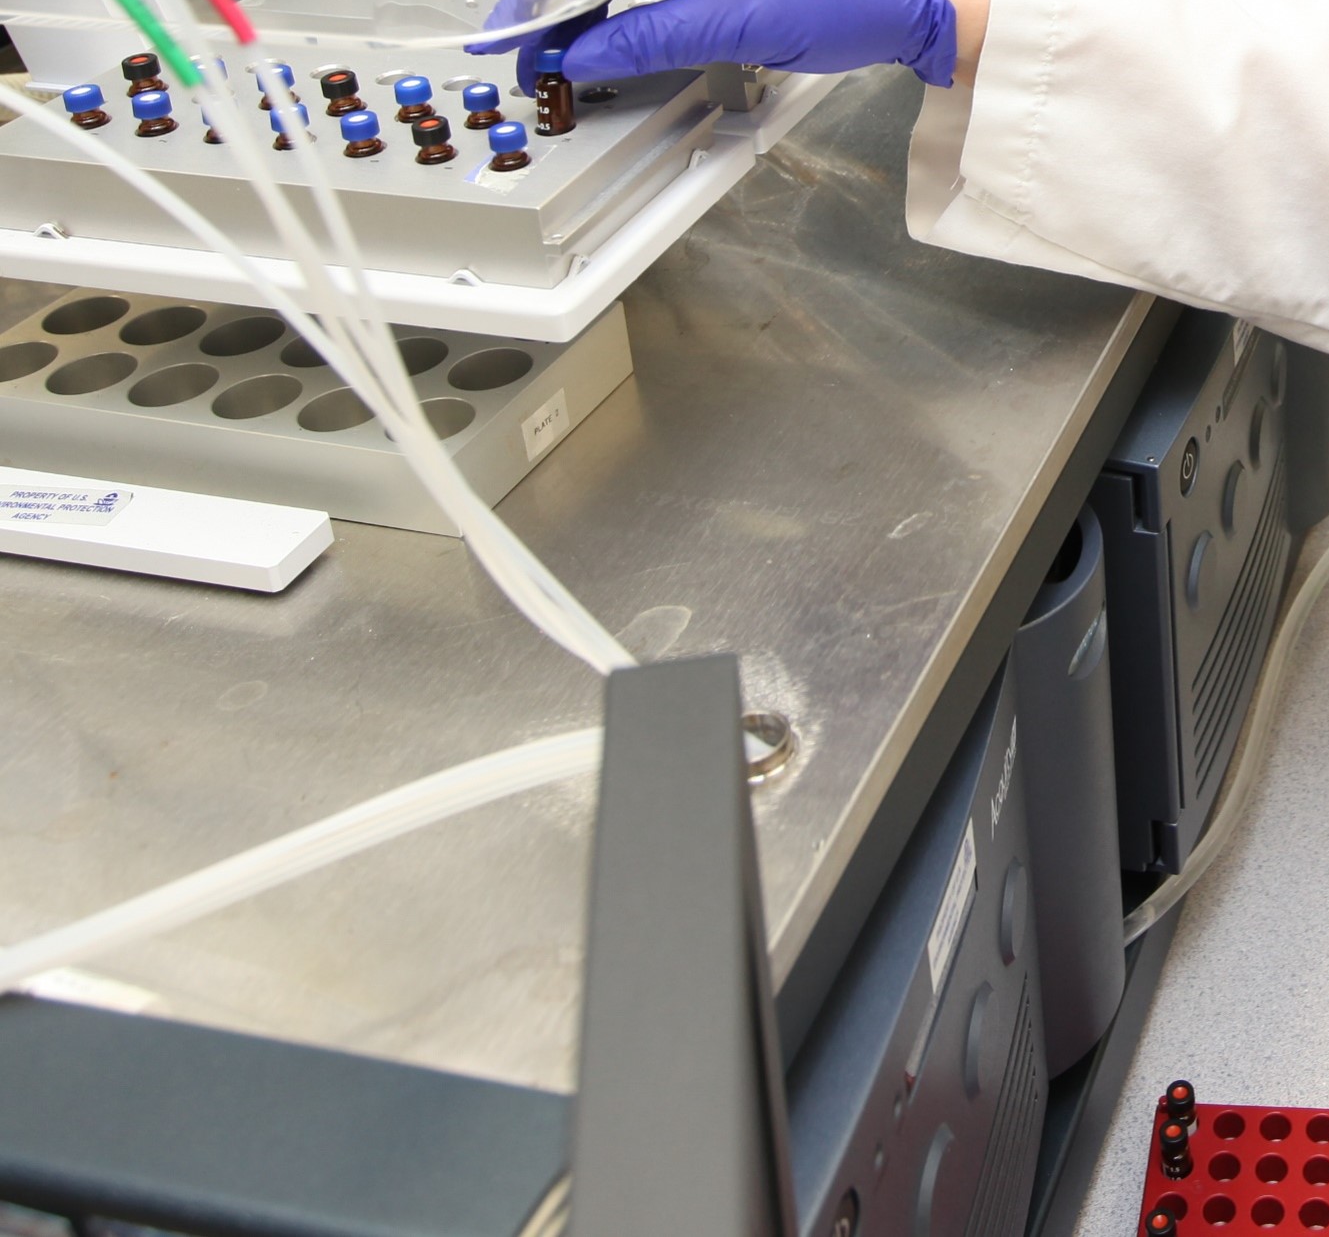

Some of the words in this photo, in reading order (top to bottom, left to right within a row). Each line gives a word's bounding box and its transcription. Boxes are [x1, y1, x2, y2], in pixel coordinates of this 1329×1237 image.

[534, 413, 553, 436] PLATE
[10, 491, 58, 501] PROPERTY
[57, 493, 73, 501] OF
[57, 503, 115, 514] PROTECTION
[11, 512, 52, 521] AGENCY
